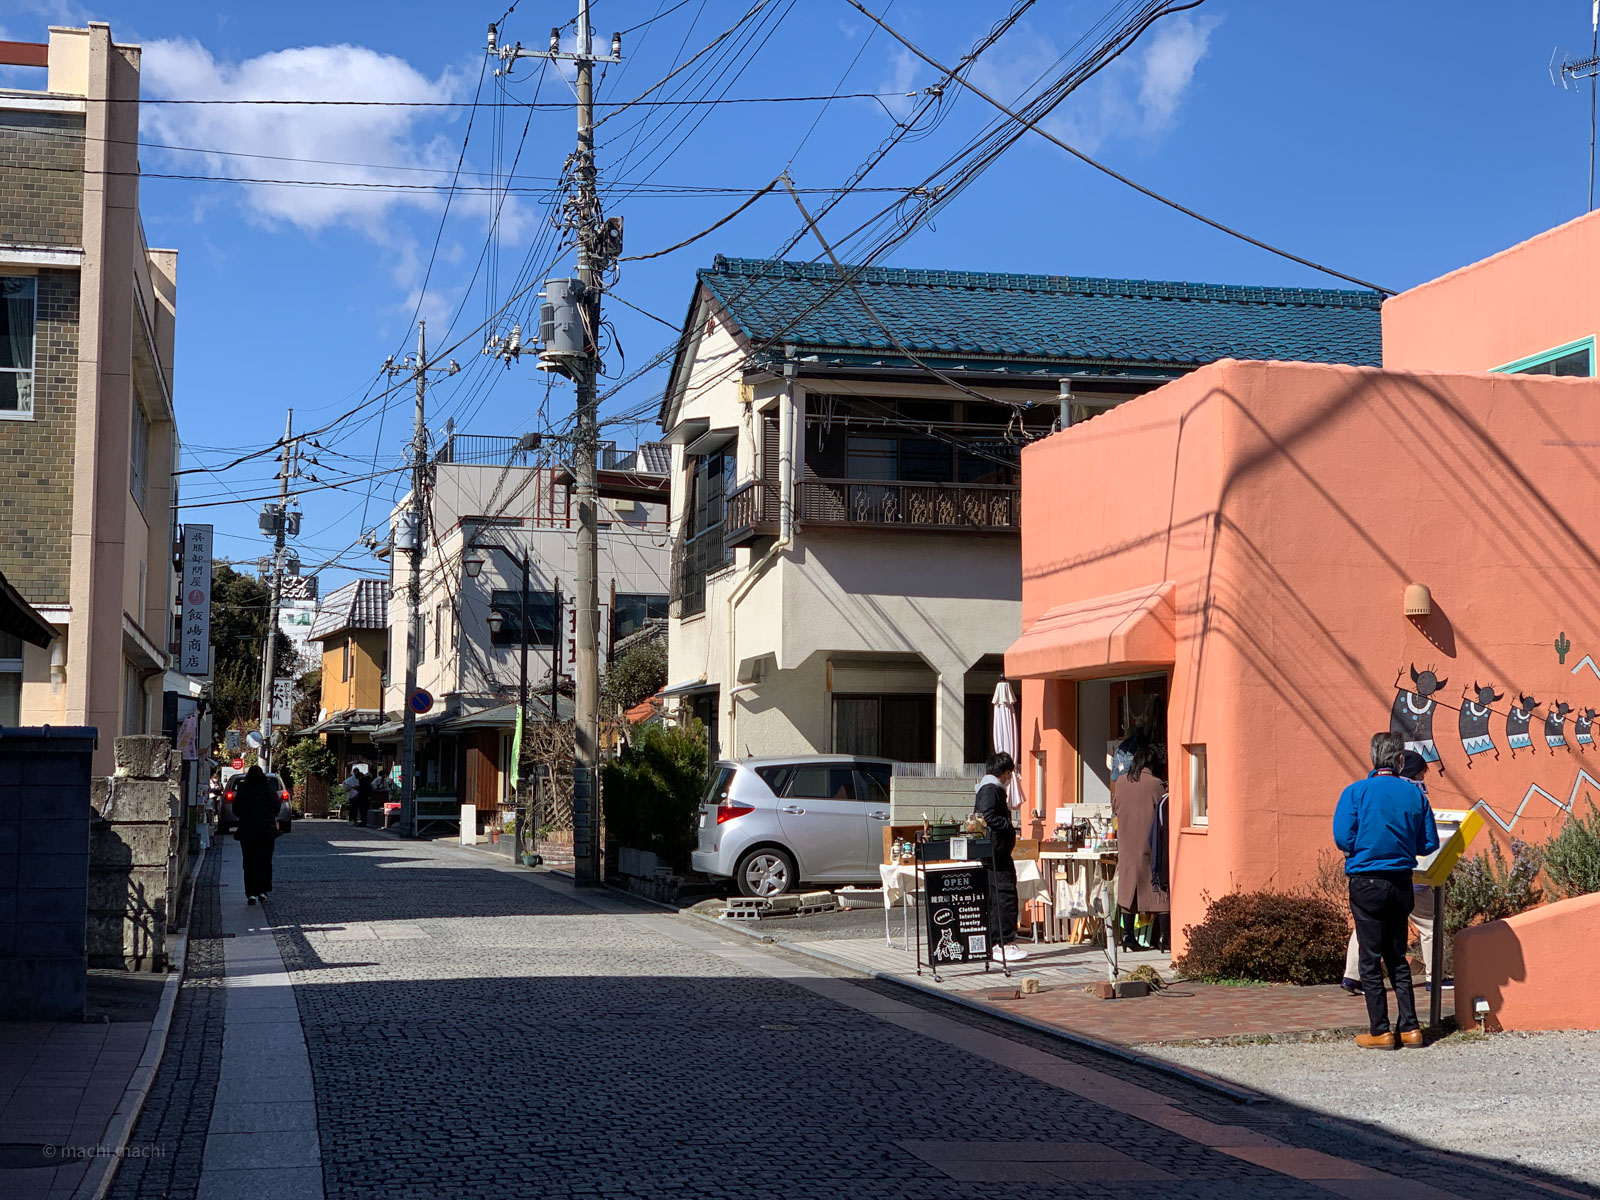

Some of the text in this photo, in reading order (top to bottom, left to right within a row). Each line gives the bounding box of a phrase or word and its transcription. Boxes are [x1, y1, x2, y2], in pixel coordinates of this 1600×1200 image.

[186, 608, 204, 668] 飯嶋商店
[944, 878, 970, 886] OPEN
[951, 893, 985, 902] Namjai
